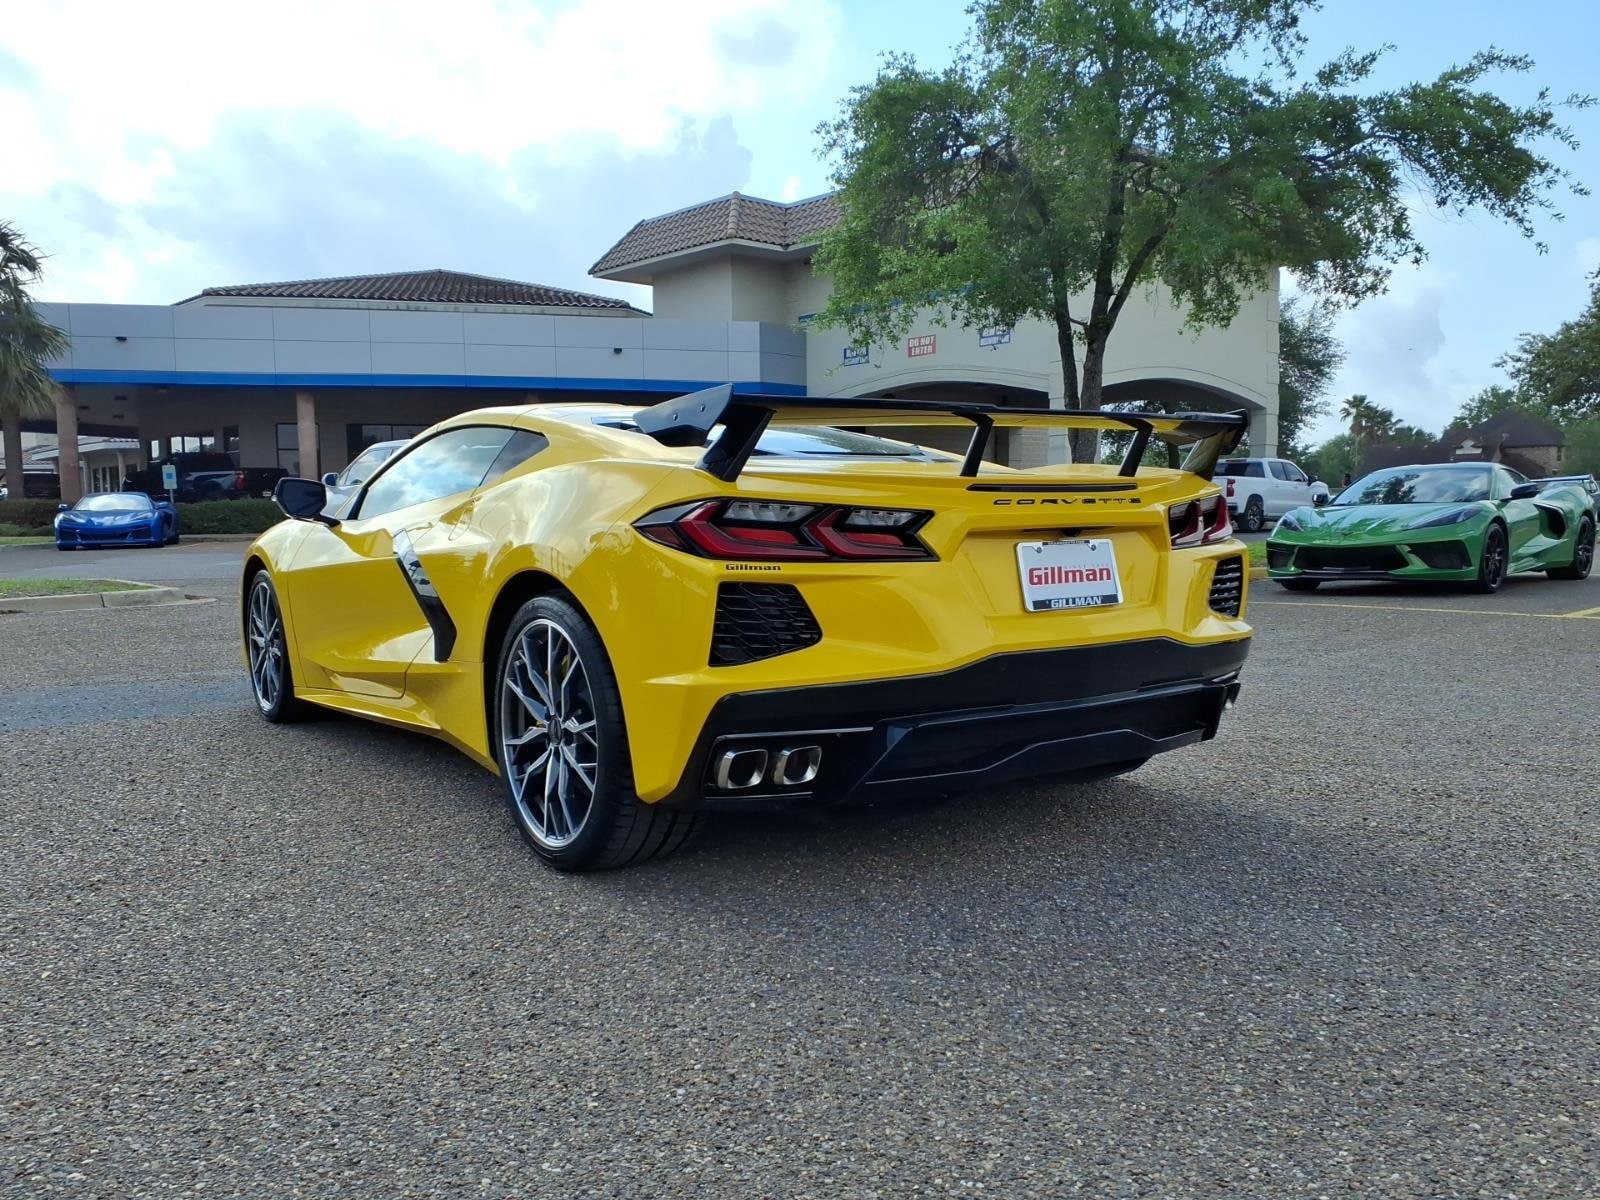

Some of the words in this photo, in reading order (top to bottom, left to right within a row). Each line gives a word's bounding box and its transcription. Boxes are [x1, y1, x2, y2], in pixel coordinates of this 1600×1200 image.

[909, 338, 919, 347] DO
[920, 335, 935, 346] NOT
[911, 345, 933, 356] ENTER
[725, 563, 781, 571] Gillman
[1028, 566, 1112, 586] Gillman
[1050, 596, 1101, 608] GILLMAN
